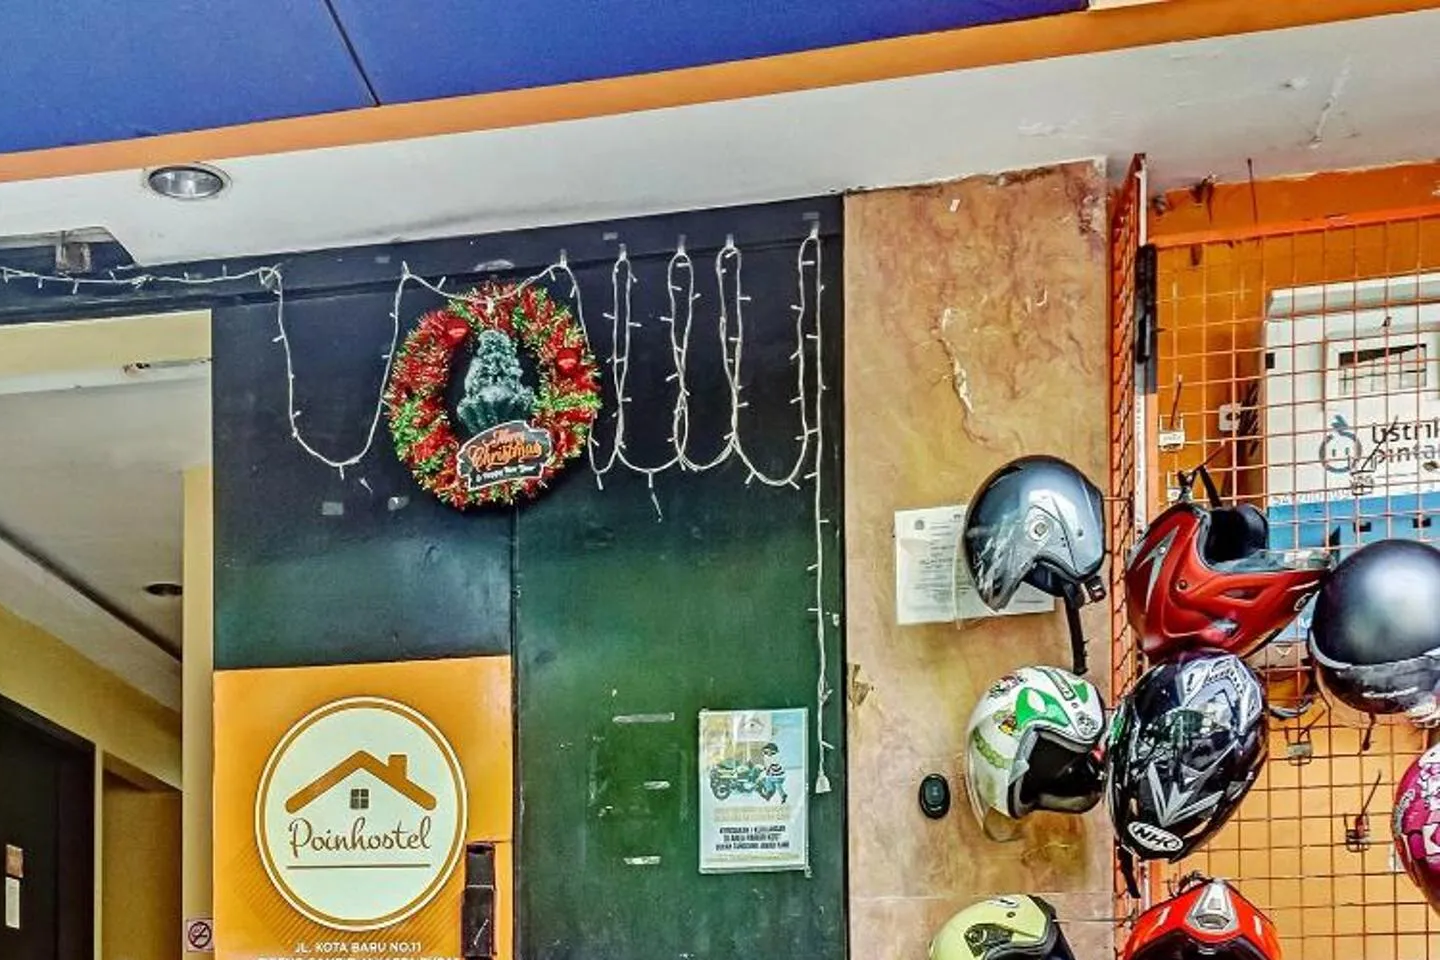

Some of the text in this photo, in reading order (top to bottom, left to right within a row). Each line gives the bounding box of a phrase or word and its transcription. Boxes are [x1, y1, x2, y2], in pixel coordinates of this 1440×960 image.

[468, 439, 542, 472] Christmas
[288, 815, 432, 858] Poinhostel
[295, 943, 311, 953] JL.
[315, 942, 347, 953] KOTA
[351, 942, 386, 952] BARU
